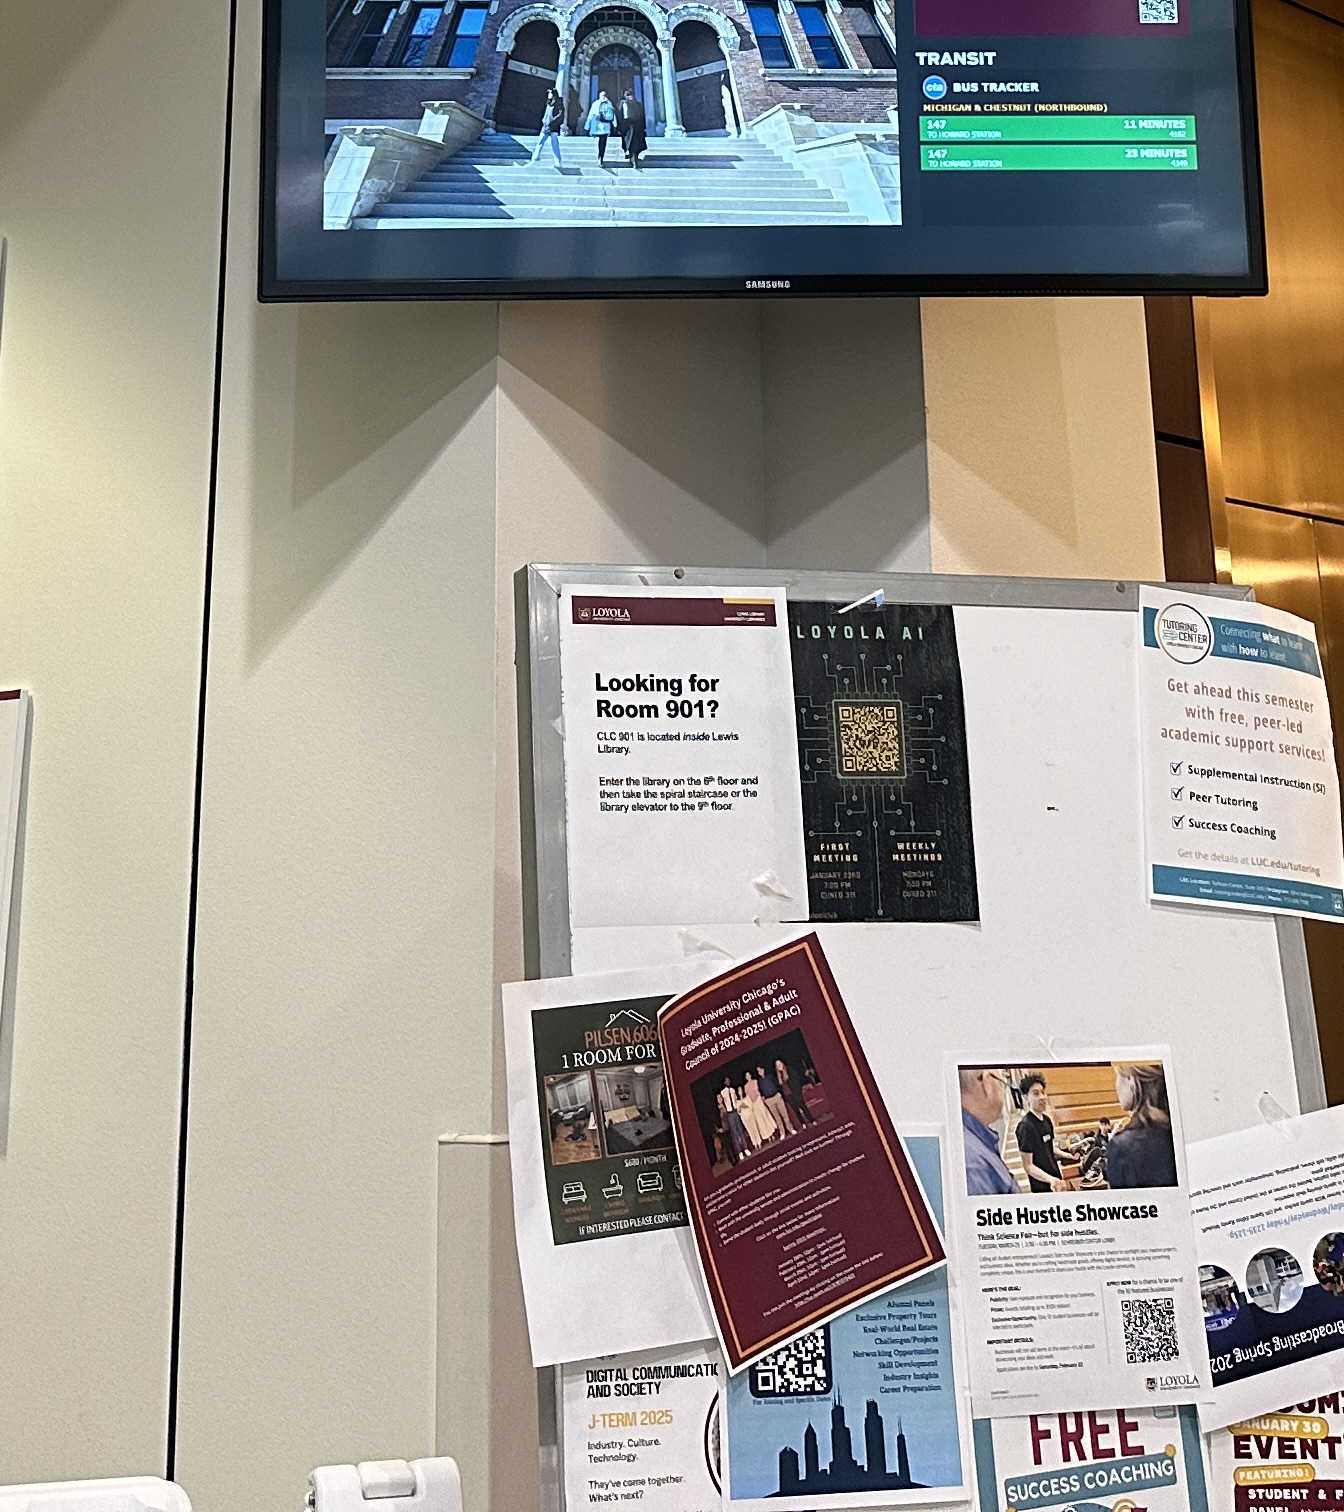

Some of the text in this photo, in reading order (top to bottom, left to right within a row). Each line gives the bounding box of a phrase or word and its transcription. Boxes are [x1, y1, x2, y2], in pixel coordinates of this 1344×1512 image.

[915, 51, 997, 66] TRANSIT
[953, 82, 1039, 93] BUS TRACKER
[923, 103, 1108, 113] MICHIGAN & CHESTNUT (NORTHBOUND)
[927, 119, 1186, 129] 147 11 MINUTES
[928, 149, 1188, 159] 147 23 MINUTES
[745, 280, 791, 288] SAMSUNG
[592, 607, 630, 618] LOYOLA
[796, 625, 924, 641] LOYOLA AI
[1162, 618, 1198, 633] TUTORING
[1178, 630, 1208, 644] CENTER
[595, 673, 720, 697] Looking for
[1167, 678, 1314, 713] Get ahead this semester
[596, 699, 719, 718] Room 901?
[1184, 705, 1303, 734] with free, peer-led
[597, 731, 739, 741] CLC 901 is located inside Lewis
[597, 744, 631, 756] Library.
[1160, 727, 1326, 762] academic support services!
[1187, 764, 1326, 795] Supplemental Instruction (SI)
[599, 789, 758, 800] then take the spiral staircase or the
[1189, 791, 1259, 811] Peer Tutoring
[1188, 818, 1277, 840] Success Coaching
[819, 843, 850, 851] FIRST
[896, 842, 937, 850] WEEKLY
[813, 854, 859, 862] MEETING
[892, 853, 943, 861] MEETINGS
[681, 978, 786, 1038] Loyola University Chicago's
[680, 989, 798, 1056] Graduate, Professional & Adult
[685, 1004, 801, 1070] Council of 2024-2025! (GPAC)
[562, 1044, 656, 1069] 1 ROOM FOR
[976, 1203, 1159, 1227] Side Hustle Showcase
[886, 1301, 913, 1309] Alumni
[853, 1347, 940, 1358] Networking Opportunities
[1232, 1339, 1273, 1362] Spring
[877, 1360, 938, 1370] Skill Development
[585, 1368, 630, 1384] DIGITAL
[883, 1372, 939, 1382] Industry Insights
[1160, 1375, 1200, 1387] LOYOLA
[587, 1381, 661, 1398] AND SOCIETY
[879, 1384, 942, 1394] Career Preparation
[588, 1409, 673, 1430] J-TERM 2025
[1029, 1409, 1145, 1465] FREE
[1233, 1435, 1341, 1460] EVENT
[1007, 1459, 1174, 1503] SUCCESS COACHING
[1239, 1468, 1309, 1481] FEATURING:
[588, 1475, 685, 1490] They've come together.
[588, 1490, 644, 1503] What's next?
[1248, 1489, 1309, 1500] STUDENT
[1317, 1489, 1327, 1500] &
